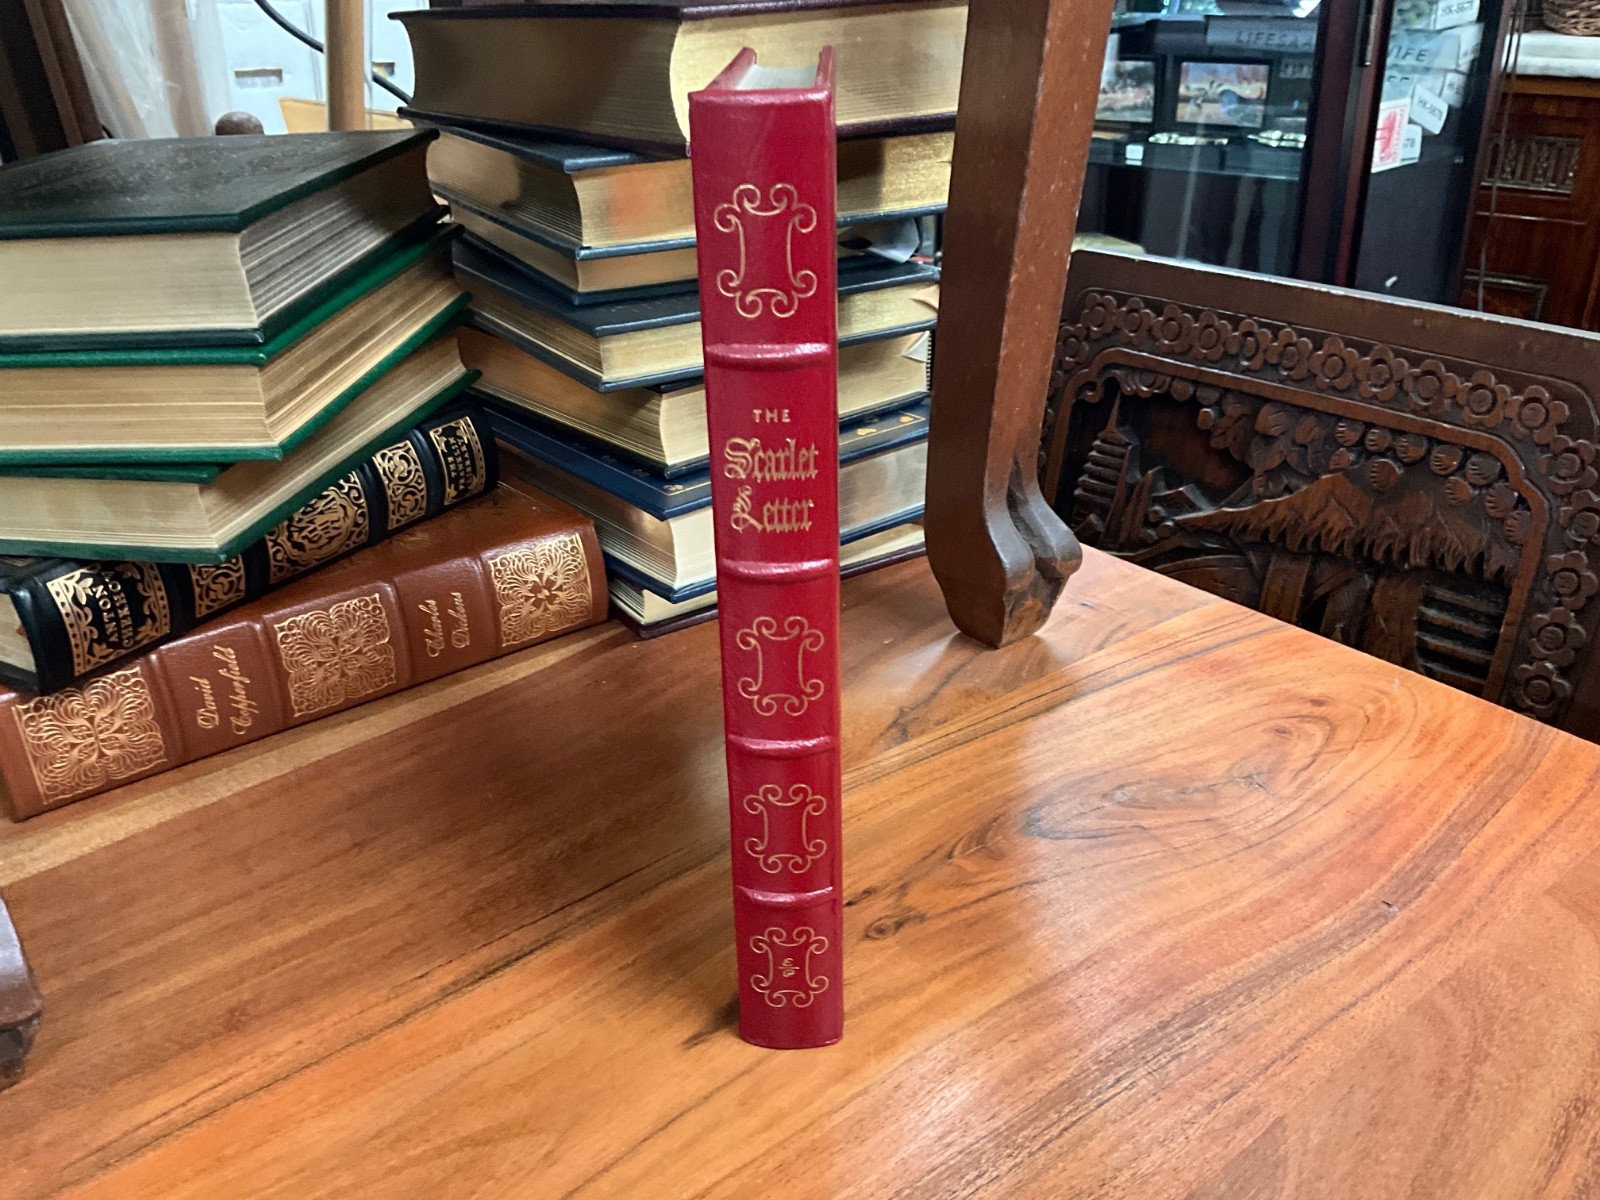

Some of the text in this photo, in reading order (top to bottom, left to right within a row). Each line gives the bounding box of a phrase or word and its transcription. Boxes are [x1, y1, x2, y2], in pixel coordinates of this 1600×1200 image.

[753, 408, 791, 423] THE
[723, 437, 819, 483] Scarlet
[730, 485, 815, 533] Letter
[91, 584, 119, 642] ANTON
[418, 599, 445, 657] Charles
[447, 592, 470, 648] Dickens
[189, 675, 219, 729] David
[211, 644, 260, 735] Copperfield
